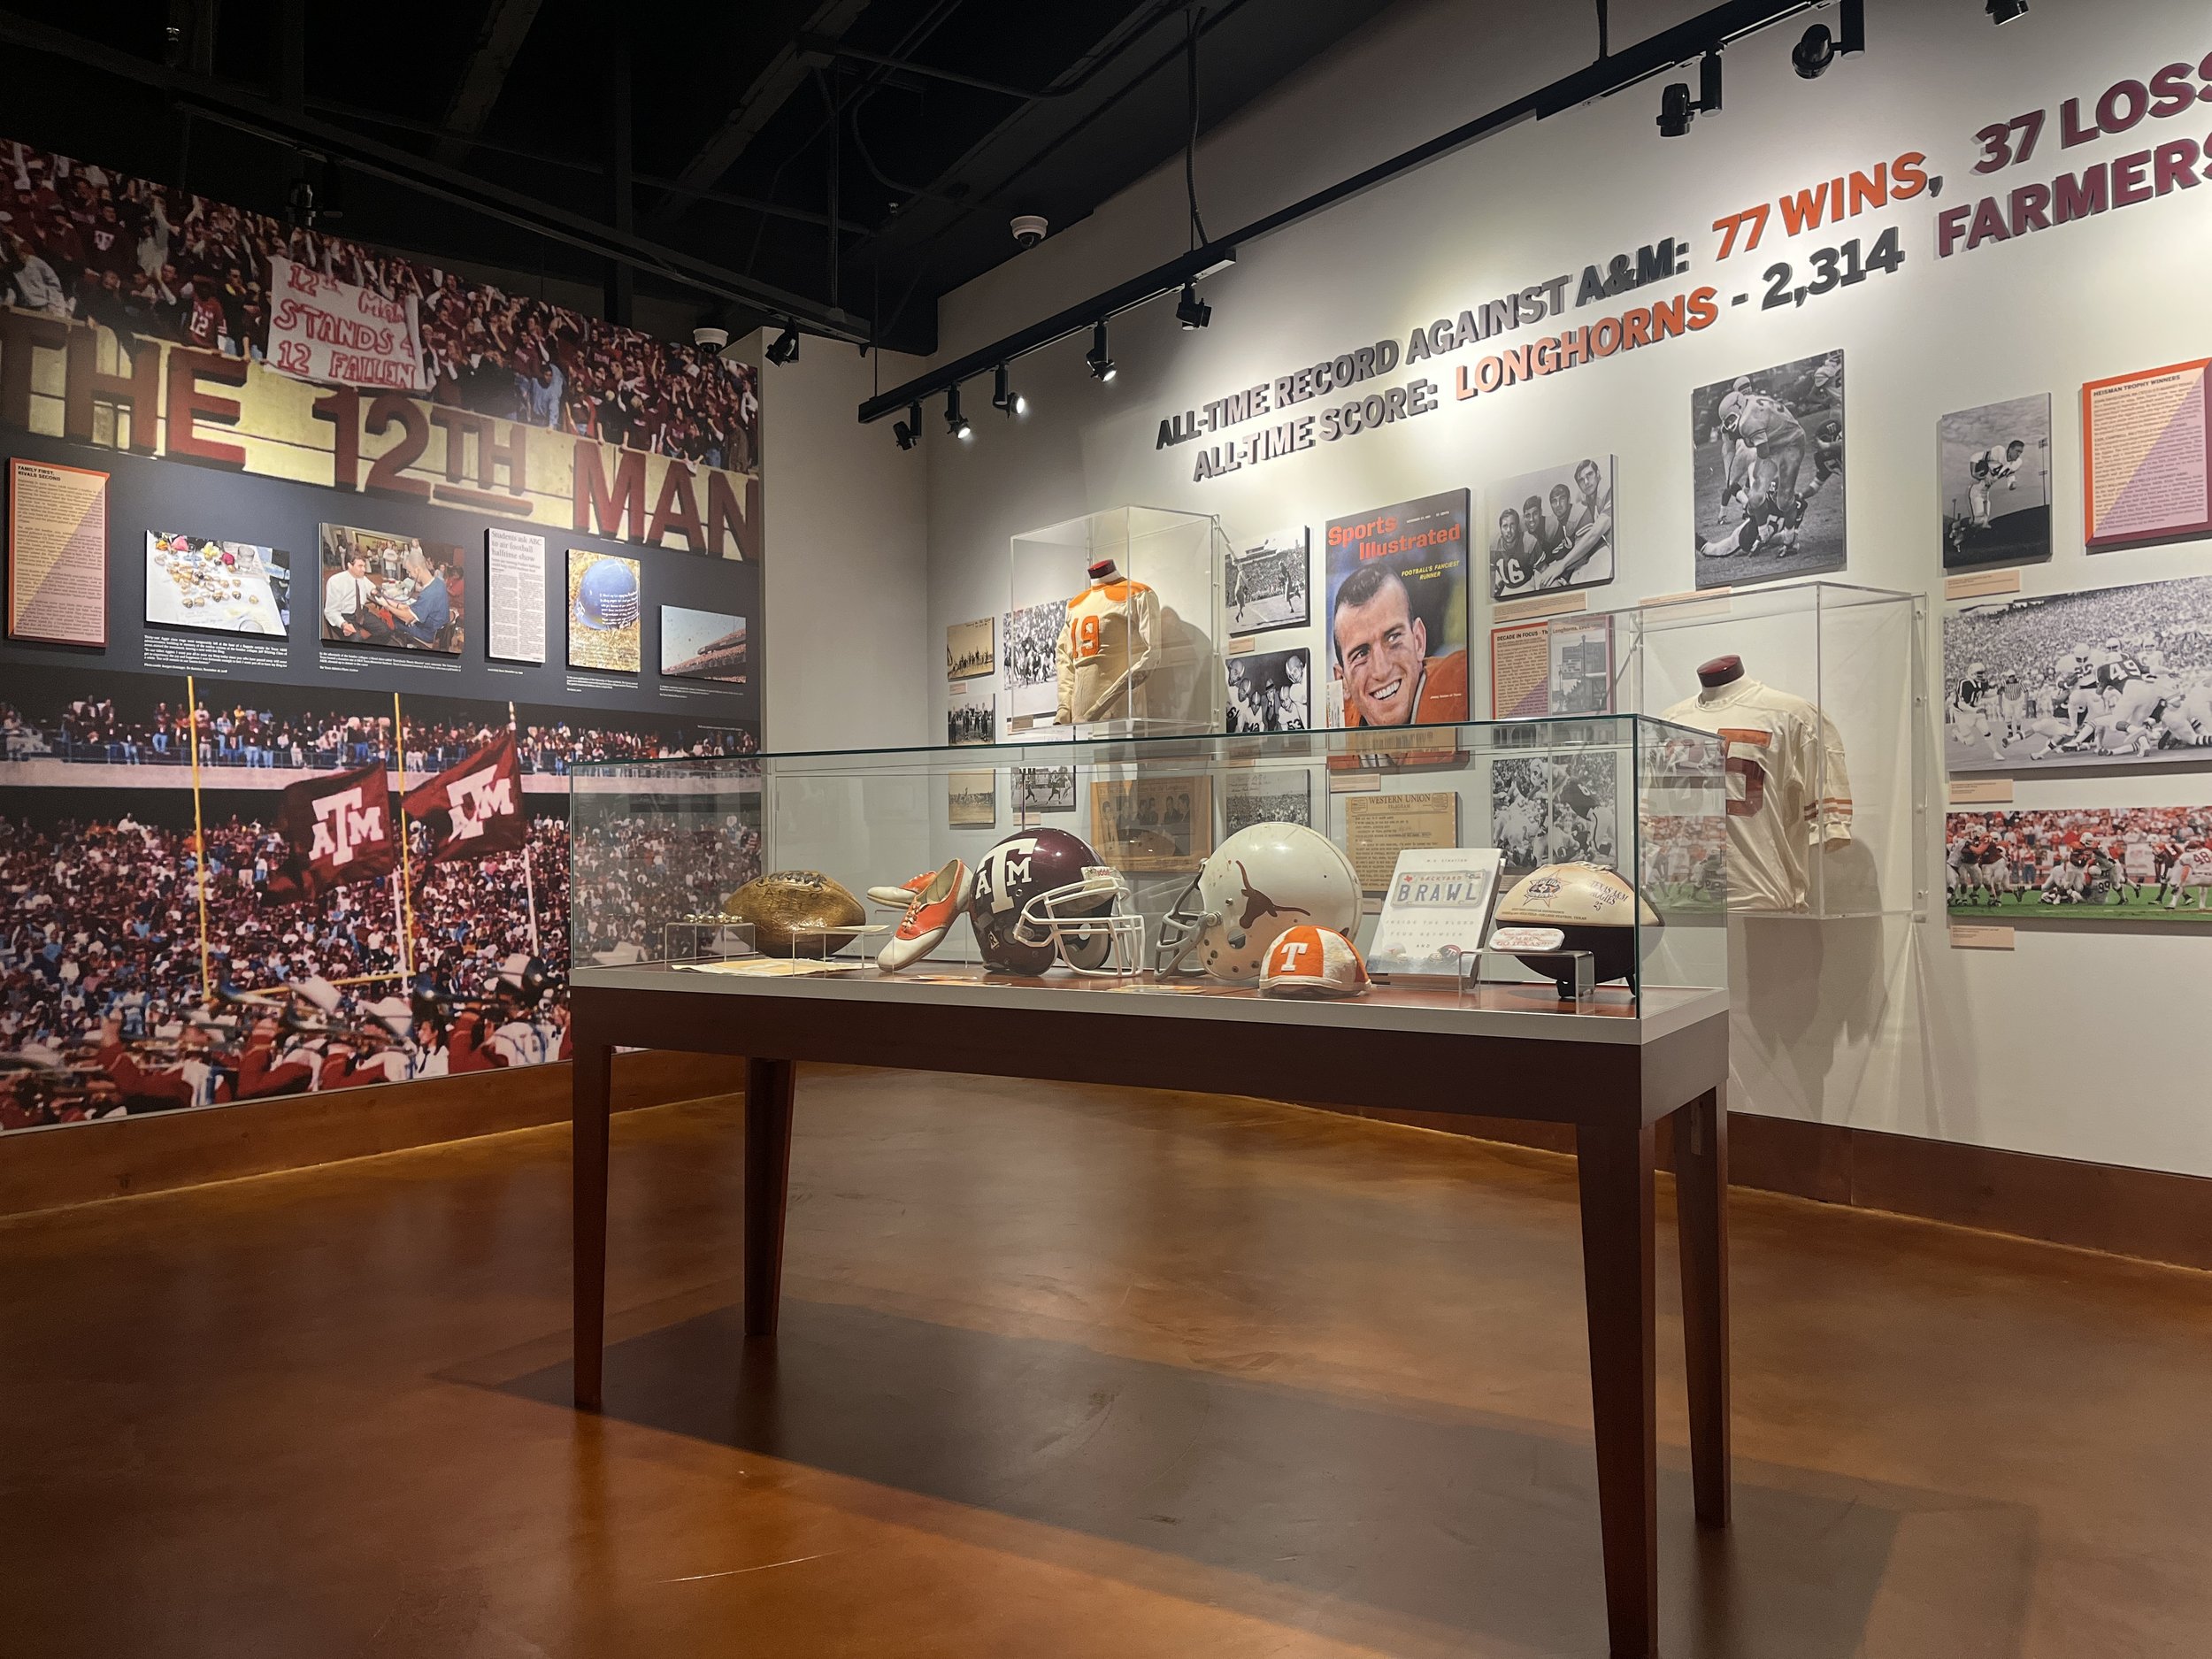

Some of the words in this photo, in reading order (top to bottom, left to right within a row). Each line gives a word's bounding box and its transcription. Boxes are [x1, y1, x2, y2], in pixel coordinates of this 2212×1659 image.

[1156, 382, 1270, 449] ALL-TIME
[1274, 339, 1402, 409] RECORD
[1406, 275, 1571, 365] AGAINST
[1576, 235, 1689, 307] A&M:
[1712, 204, 1770, 261] 77
[1779, 152, 1943, 237] WINS,
[1975, 109, 2046, 173] 37
[273, 298, 395, 355] STANDS
[278, 340, 311, 374] 12
[329, 350, 417, 389] FALLEN
[1194, 415, 1315, 482] ALL-TIME
[1319, 378, 1438, 442] SCORE:
[1455, 287, 1718, 402] LONGHORNS
[1761, 227, 1906, 311] 2,314
[2093, 386, 2123, 397] HEISMAN
[2124, 380, 2149, 392] TROPHY
[2150, 374, 2181, 386] WINNERS
[312, 388, 516, 503] 12TH
[572, 442, 758, 561] MAN
[491, 531, 517, 541] Students
[518, 534, 527, 543] ask
[528, 536, 542, 546] ABC
[1328, 516, 1398, 549] Sports
[1359, 523, 1461, 562] Illustrated
[491, 539, 498, 548] to
[499, 541, 509, 549] air
[510, 541, 534, 554] football
[491, 548, 518, 559] halftime
[518, 552, 535, 563] show
[1401, 565, 1432, 578] FOOTBALL'S
[1433, 560, 1460, 572] FANCIEST
[1419, 571, 1441, 581] RUNNER
[1496, 558, 1525, 584] 16
[1071, 615, 1100, 659] 19
[1497, 633, 1516, 641] DECADE
[2109, 659, 2141, 681] 49
[1369, 795, 1402, 804] WESTERN
[1405, 793, 1431, 803] UNION
[1397, 883, 1477, 902] BRAWL
[1590, 892, 1617, 905] AGGIES
[1591, 880, 1614, 895] TEXAS
[1594, 901, 1603, 911] 25
[1281, 942, 1309, 972] T
